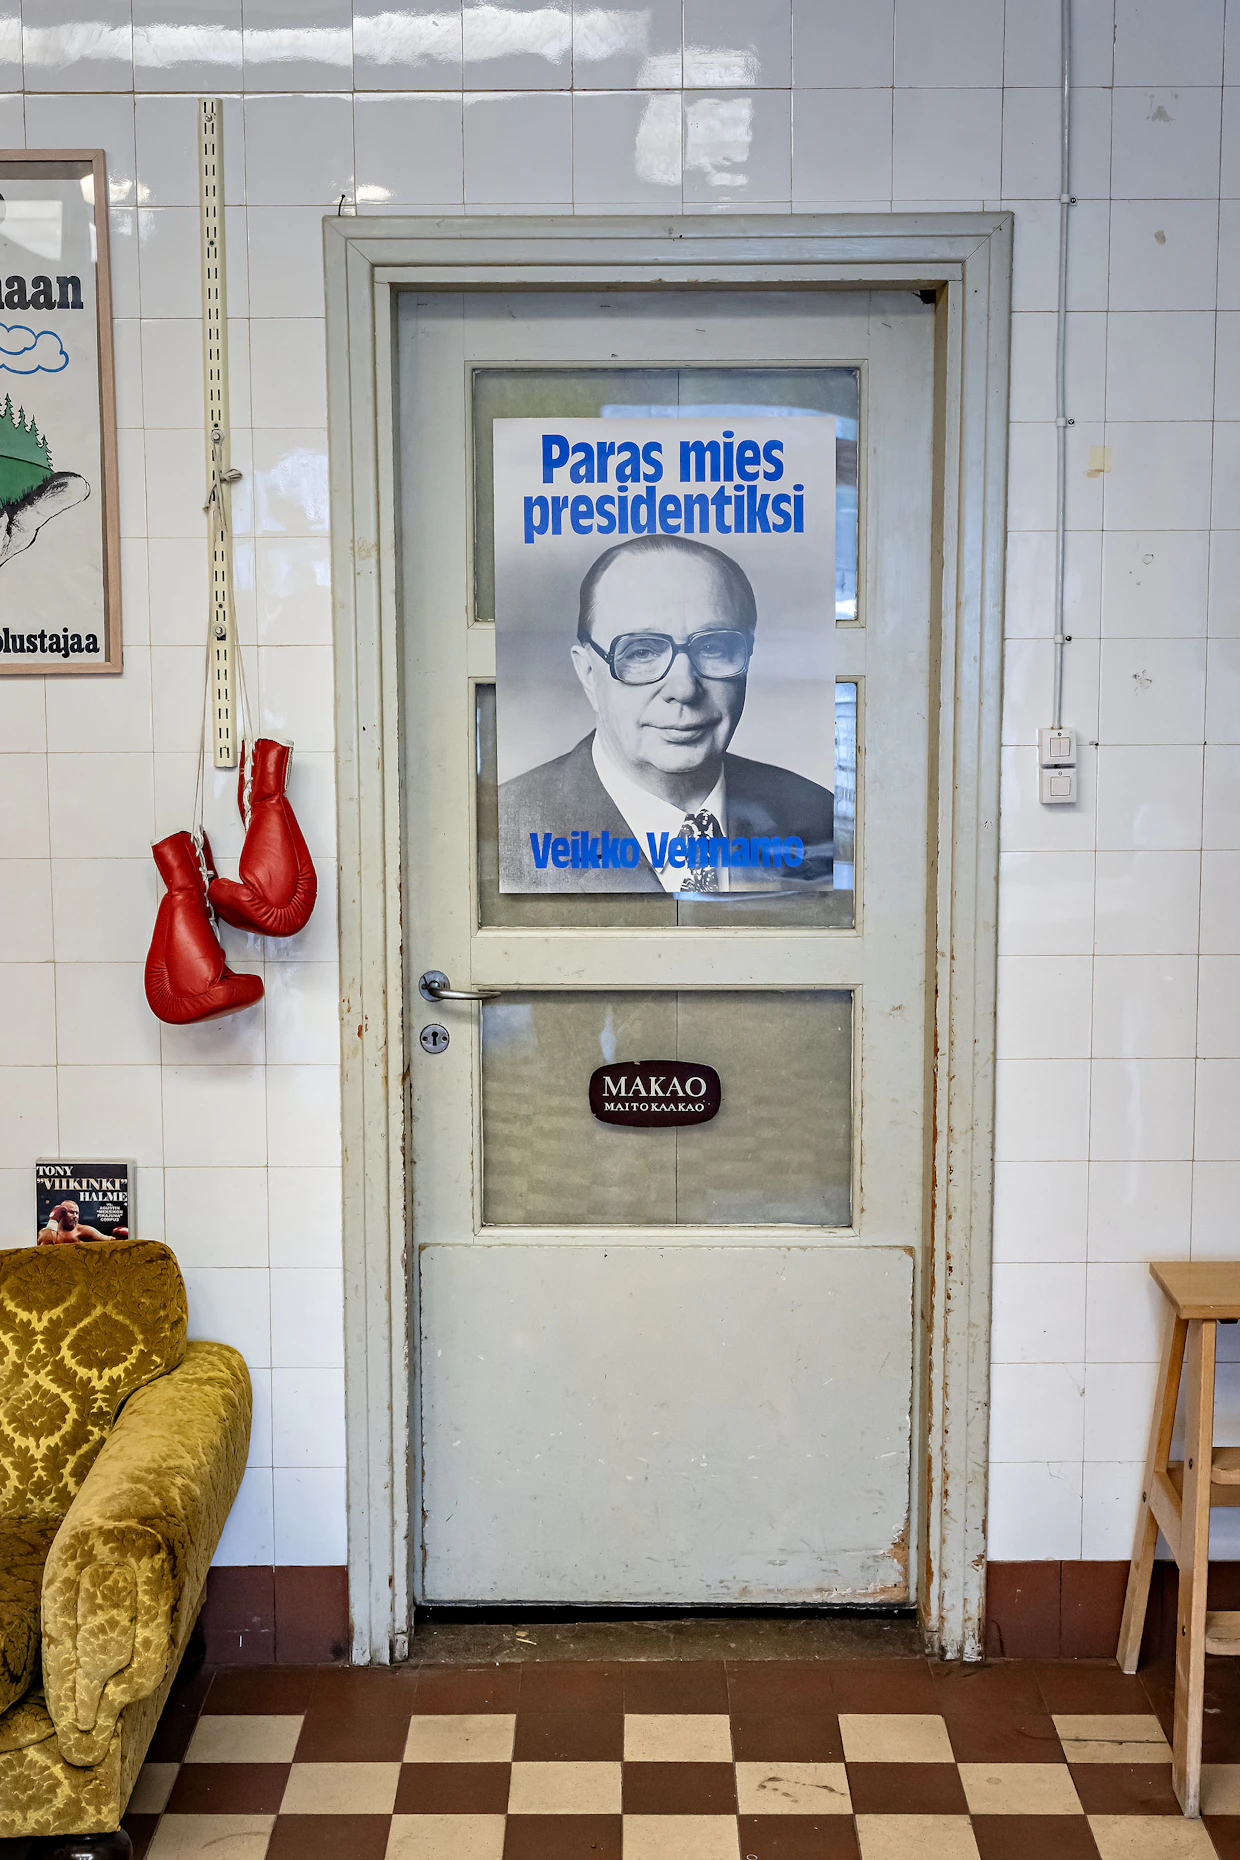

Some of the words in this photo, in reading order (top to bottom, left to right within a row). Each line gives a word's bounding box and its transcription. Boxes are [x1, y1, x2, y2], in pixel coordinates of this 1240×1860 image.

[0, 275, 84, 311] aan
[541, 434, 664, 484] Paras
[679, 430, 784, 483] mies
[523, 484, 805, 544] presidentiksi
[529, 831, 641, 869] Veikko
[646, 831, 805, 869] Vennamo
[602, 1076, 707, 1098] MAKAO
[36, 1165, 73, 1176] TONY
[79, 1191, 128, 1202] HALME
